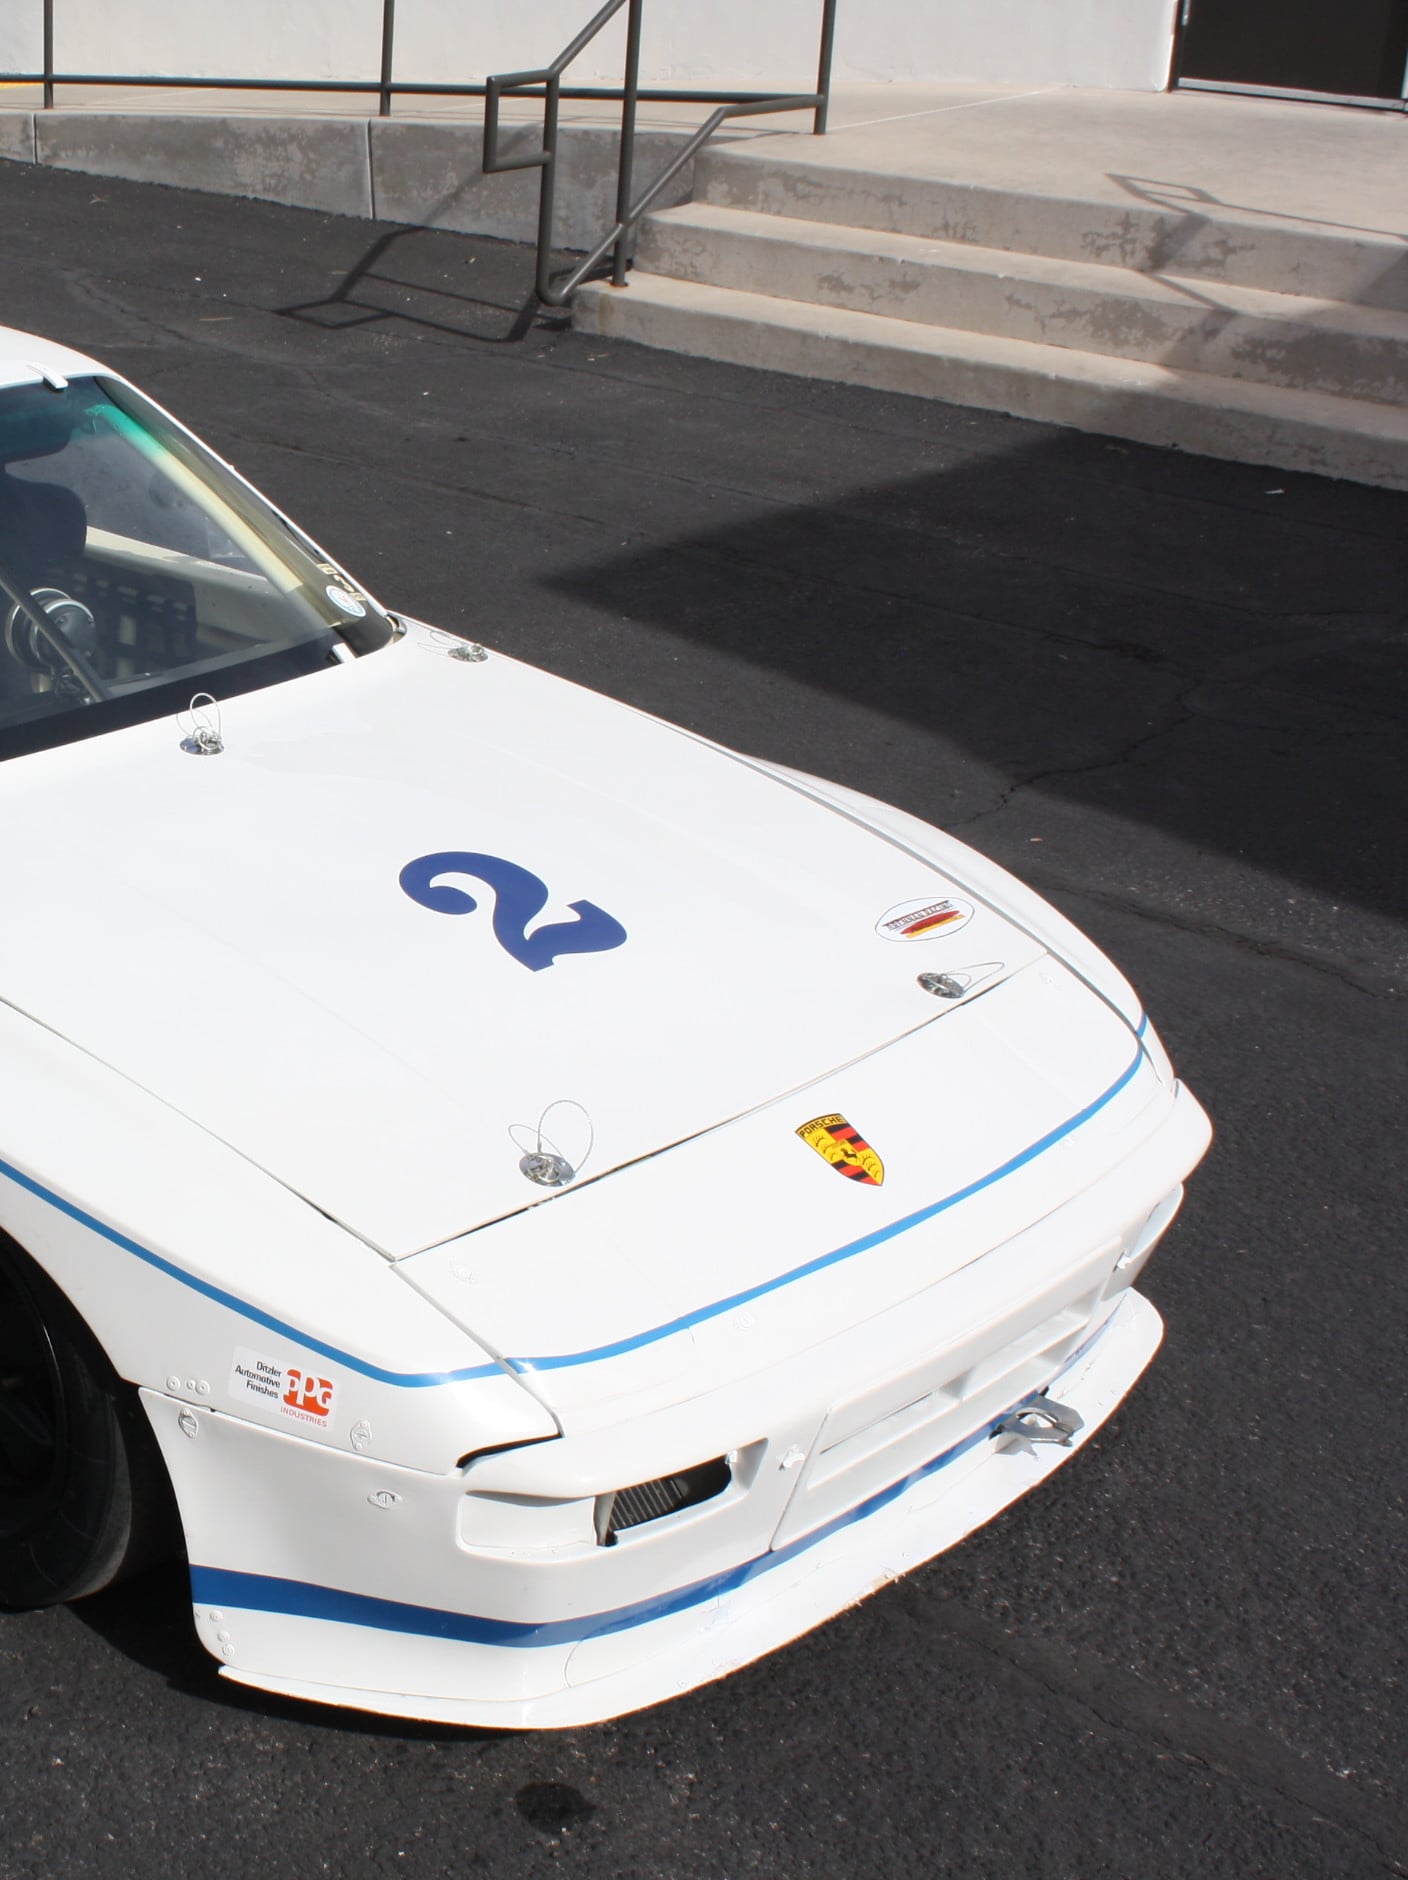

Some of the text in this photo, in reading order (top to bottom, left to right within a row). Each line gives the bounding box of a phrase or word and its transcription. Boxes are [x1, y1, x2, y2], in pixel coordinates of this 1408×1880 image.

[398, 851, 628, 972] 2
[799, 1116, 843, 1138] PORSCHE
[235, 1364, 281, 1388] Automotive
[256, 1361, 282, 1378] Ditzler
[246, 1379, 279, 1399] Finishes
[280, 1406, 328, 1428] INDUSTRIES
